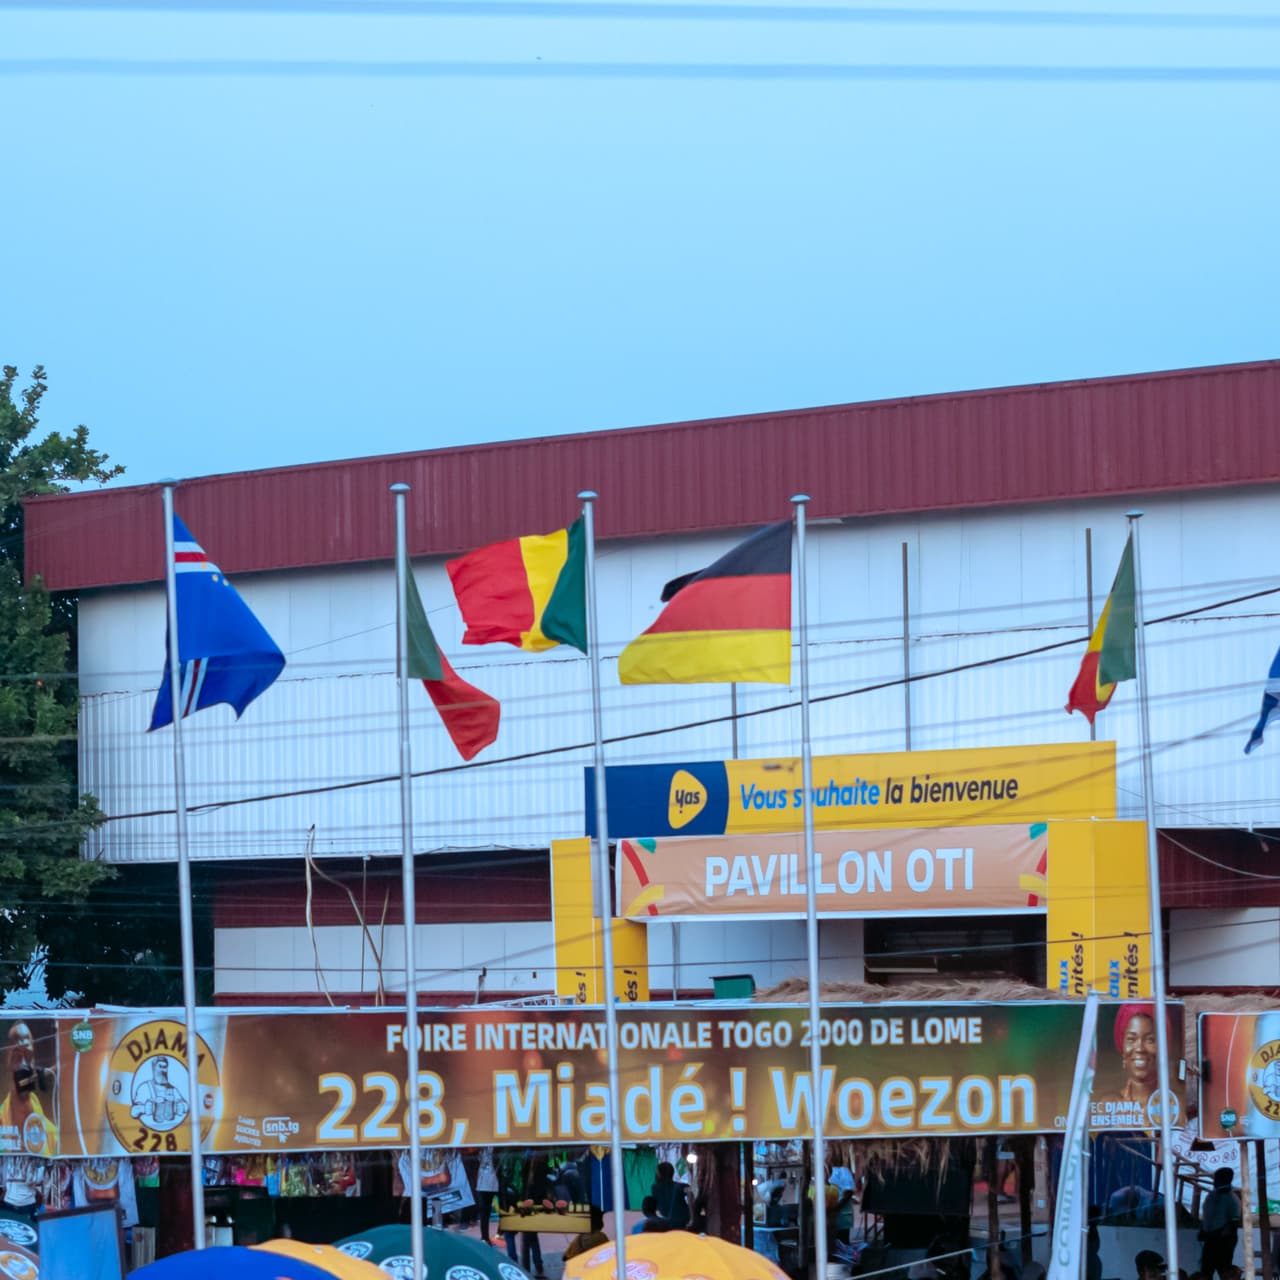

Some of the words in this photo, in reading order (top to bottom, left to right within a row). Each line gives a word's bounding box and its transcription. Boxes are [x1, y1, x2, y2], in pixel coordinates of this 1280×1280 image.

[740, 783, 787, 810] Vous
[885, 777, 903, 805] la
[910, 775, 1019, 803] bienvenue
[705, 850, 892, 897] PAVILLON
[906, 847, 974, 892] OTI
[73, 1029, 93, 1041] SNB
[126, 1027, 206, 1070] DJAMA
[386, 1024, 466, 1052] FOIRE
[475, 1021, 712, 1051] INTERNATONALE
[718, 1020, 792, 1048] TOGO
[800, 1019, 863, 1046] 2000
[871, 1019, 904, 1045] DE
[910, 1017, 982, 1044] LOME
[318, 1071, 469, 1145] 228,
[493, 1062, 707, 1138] Miadé
[768, 1065, 1037, 1133] Woezon
[1221, 1112, 1237, 1123] SNB
[265, 1119, 299, 1134] snb.tg
[1091, 1114, 1144, 1126] ENSEMBLE
[132, 1129, 179, 1152] 228
